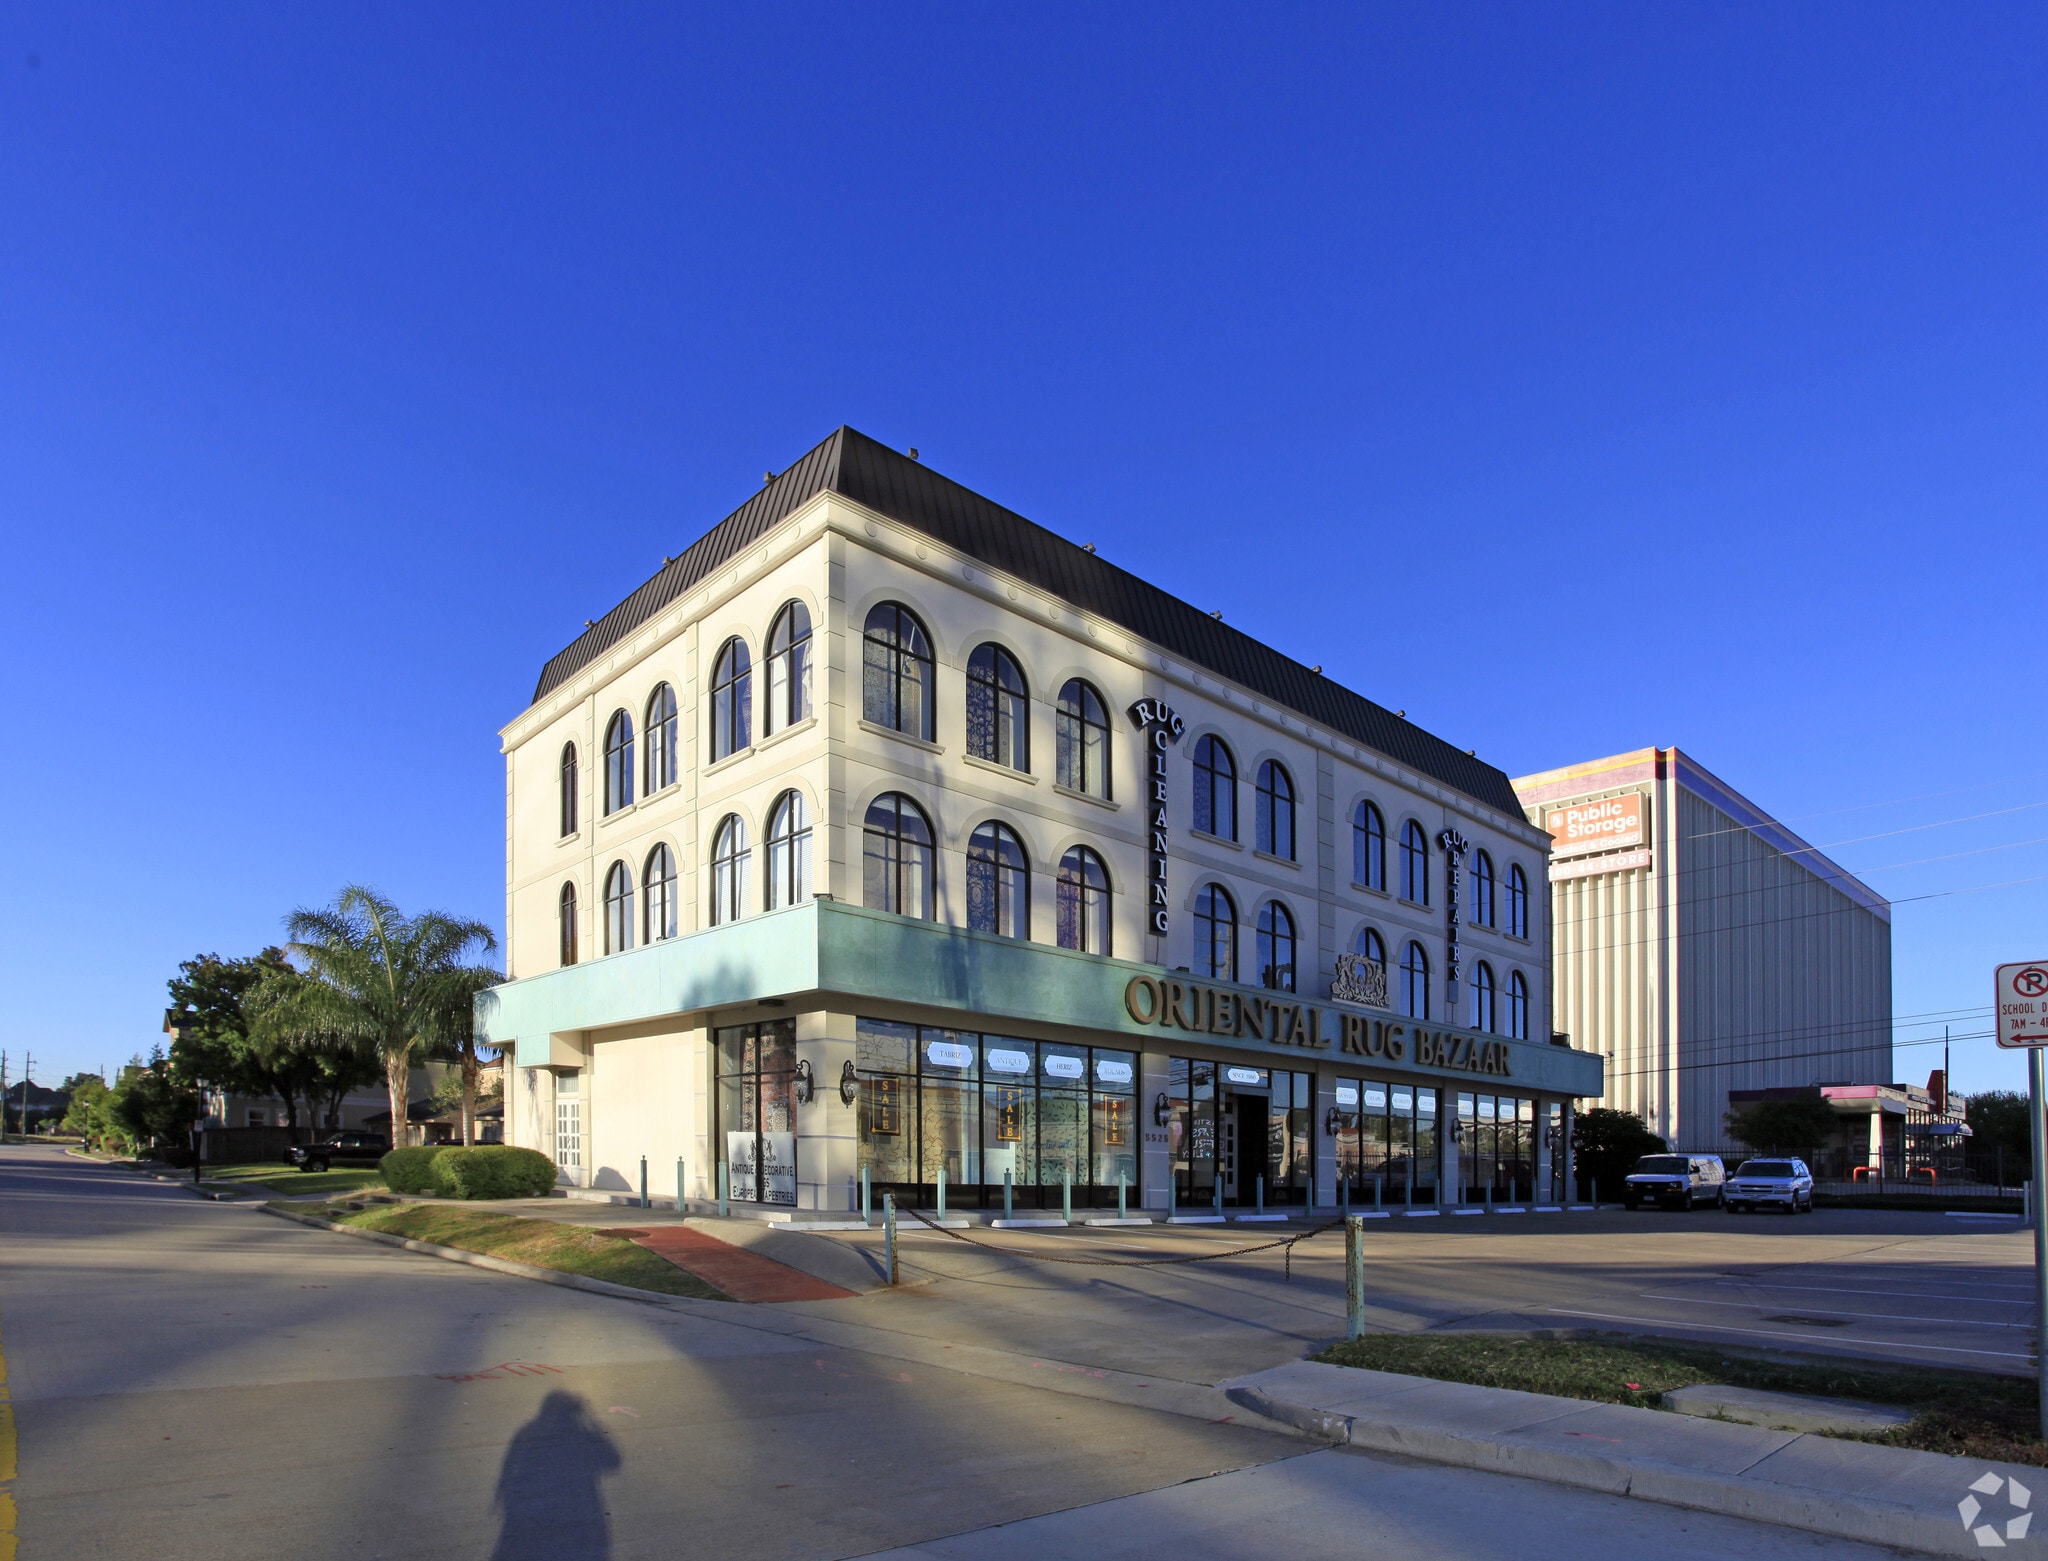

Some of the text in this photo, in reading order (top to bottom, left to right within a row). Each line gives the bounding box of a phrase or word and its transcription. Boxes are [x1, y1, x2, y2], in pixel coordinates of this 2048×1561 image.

[1136, 700, 1185, 735] RUG
[1567, 802, 1623, 825] Public
[1155, 730, 1169, 932] CLEANING
[1567, 815, 1637, 838] Storage
[1442, 829, 1470, 853] RUG
[1453, 850, 1461, 981] REPAIRS
[1125, 975, 1332, 1049] ORIENTAL
[2002, 1003, 2035, 1016] SCHOOL
[2011, 1018, 2026, 1030] 7AM
[939, 1050, 962, 1060] TABRIZ
[1342, 1013, 1512, 1076] RUG BAZAAR
[996, 1056, 1023, 1067] ANTIQUE
[1056, 1062, 1073, 1071] HERIZ
[881, 1081, 889, 1130] SALE
[731, 1162, 754, 1175] ANTIQUE
[733, 1186, 757, 1199] EUROPEA
